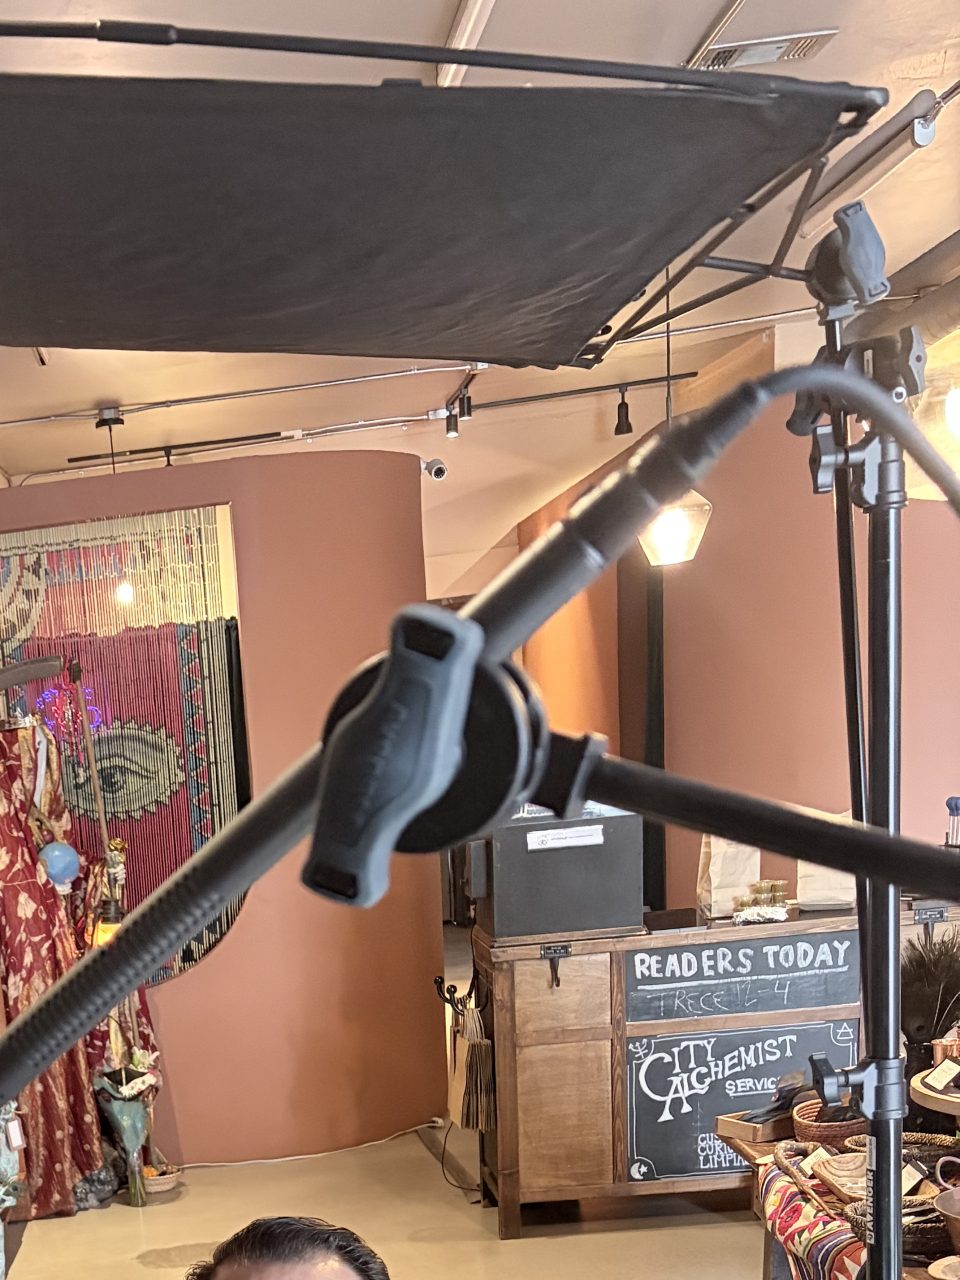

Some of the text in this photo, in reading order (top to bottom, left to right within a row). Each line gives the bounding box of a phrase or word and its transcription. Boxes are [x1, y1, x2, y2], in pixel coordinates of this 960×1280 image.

[634, 940, 851, 979] READERS TODAY
[646, 989, 729, 1016] TRECE
[639, 1037, 717, 1101] CITY
[657, 1034, 797, 1123] ALCHEMIST
[725, 1077, 781, 1094] SERVIC
[699, 1152, 750, 1169] LIMPIA
